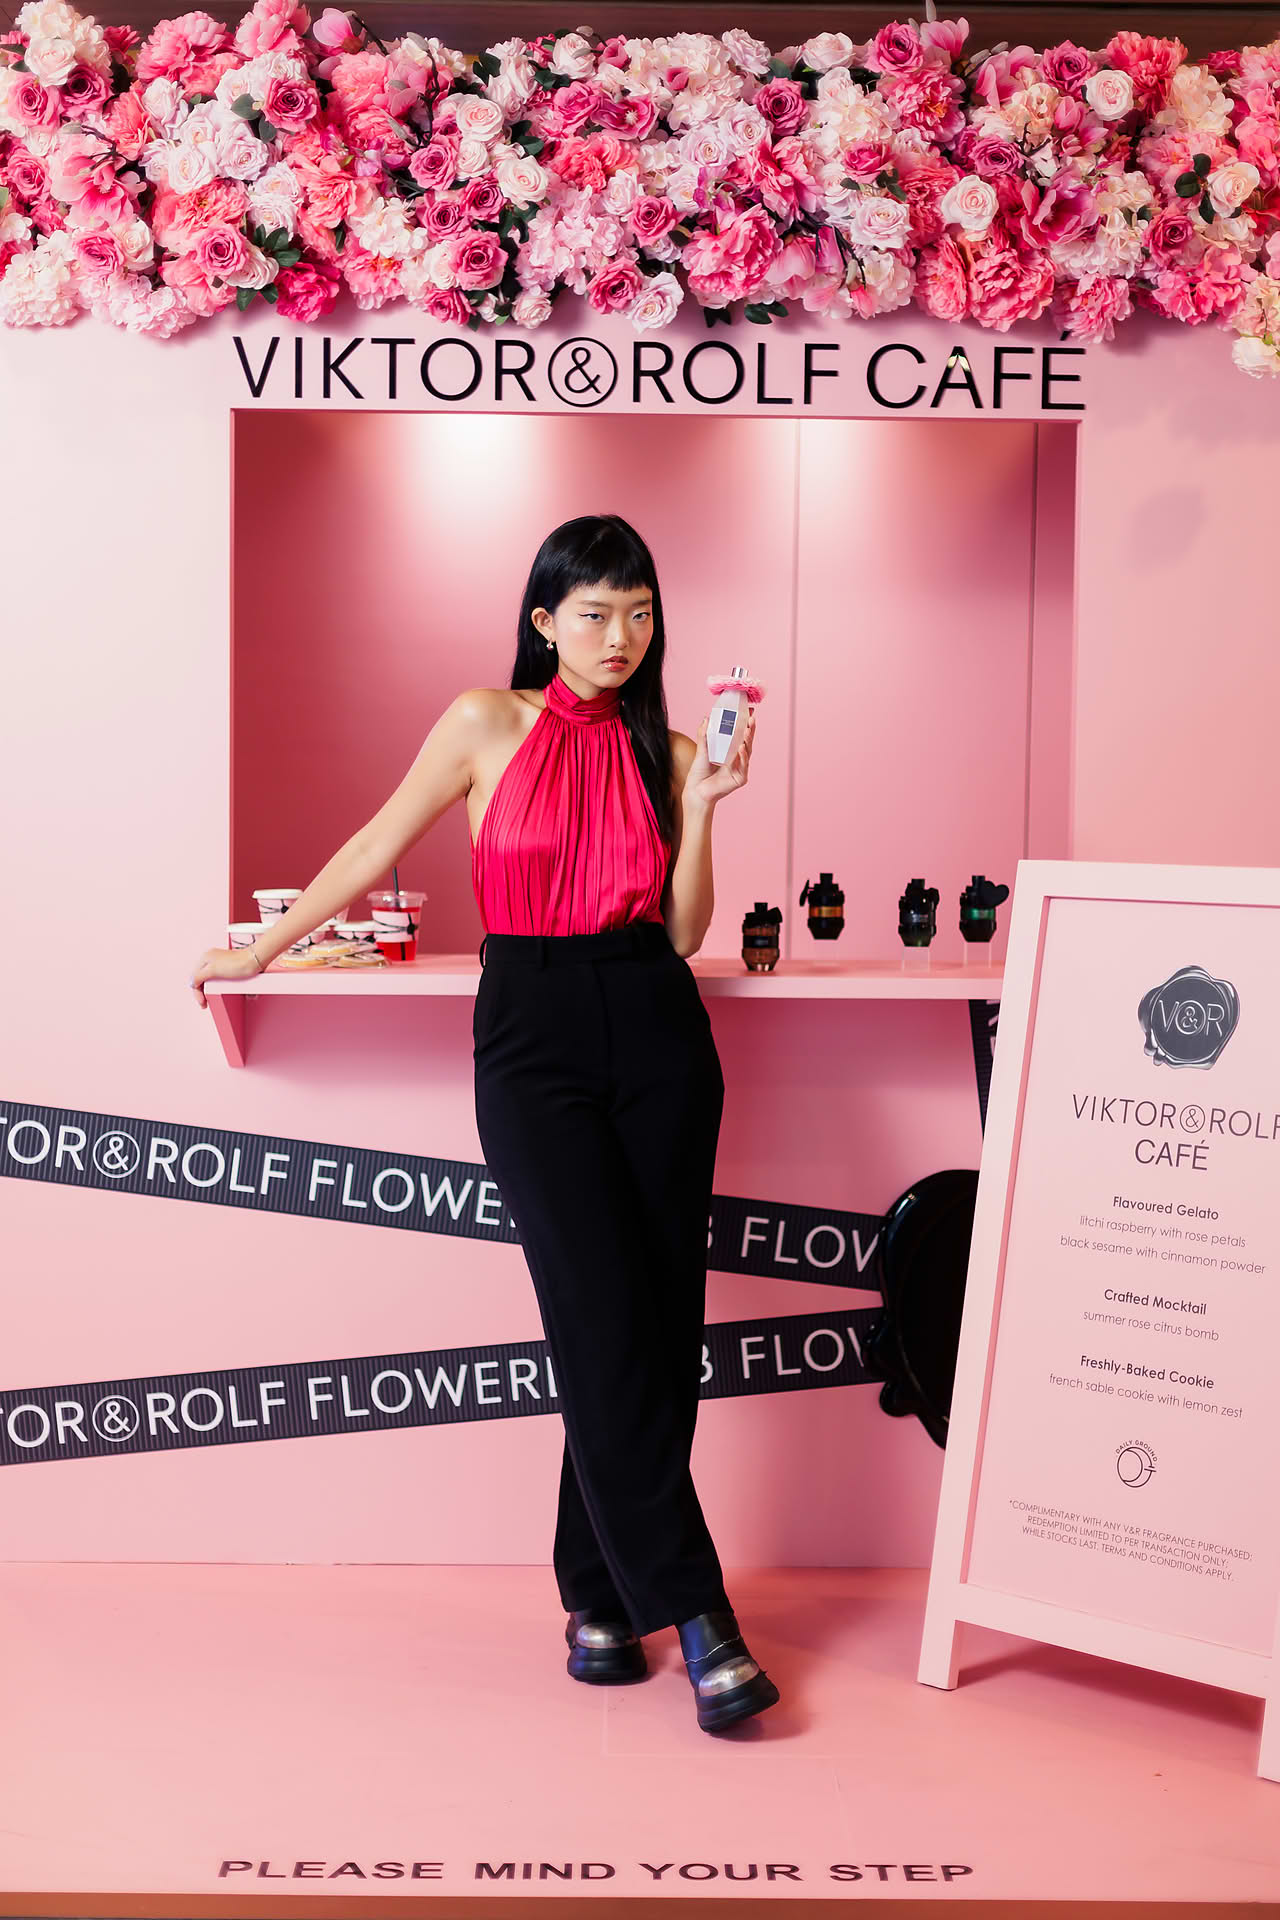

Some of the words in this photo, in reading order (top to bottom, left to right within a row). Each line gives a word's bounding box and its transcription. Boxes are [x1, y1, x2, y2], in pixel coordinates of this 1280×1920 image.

[233, 336, 840, 407] VIKTOR&ROLF
[1159, 1000, 1224, 1037] V&R
[1135, 1139, 1210, 1171] CAFÉ
[0, 1117, 290, 1195] OR&ROLF
[308, 1158, 518, 1229] FLOWE
[1113, 1196, 1173, 1214] Flavoured
[1176, 1204, 1219, 1220] Gelato
[1079, 1215, 1104, 1228] litchi
[1106, 1219, 1157, 1238] raspberry
[1160, 1226, 1182, 1239] with
[1185, 1231, 1208, 1243] rose
[1211, 1233, 1246, 1248] petals
[1060, 1235, 1089, 1249] black
[1092, 1241, 1133, 1255] sesame
[1136, 1246, 1158, 1259] with
[1161, 1249, 1217, 1267] cinnamon
[1220, 1258, 1266, 1274] powder
[1104, 1289, 1149, 1306] Crafted
[1152, 1296, 1207, 1315] Mocktail
[1083, 1311, 1126, 1326] summer
[1128, 1319, 1150, 1330] rose
[1154, 1321, 1182, 1335] citrus
[1185, 1326, 1220, 1341] bomb
[1080, 1355, 1166, 1380] Freshly-Baked
[1169, 1370, 1215, 1389] Cookie
[1049, 1373, 1083, 1389] french
[1085, 1380, 1114, 1395] sable
[1117, 1387, 1154, 1402] cookie
[1157, 1394, 1180, 1407] with
[1183, 1397, 1218, 1414] lemon
[1221, 1406, 1243, 1419] zest
[0, 1381, 286, 1449] OR&ROLF
[1115, 1440, 1132, 1454] DAILY
[1135, 1439, 1158, 1462] GROUND
[1027, 1515, 1078, 1534] REDEMPTION
[1079, 1527, 1109, 1541] LIMITED
[1111, 1534, 1122, 1544] TO
[1124, 1536, 1139, 1547] PER
[1141, 1540, 1201, 1561] TRANSACTION
[1082, 1516, 1101, 1527] WITH
[1103, 1520, 1121, 1531] ANY
[1123, 1525, 1141, 1536] V&R
[1142, 1529, 1196, 1549] FRAGRANCE
[1022, 1526, 1045, 1539] WHILE
[1046, 1531, 1077, 1546] STOCKS
[1101, 1543, 1127, 1557] TERMS
[1128, 1550, 1148, 1561] AND
[1149, 1554, 1203, 1574] CONDITIONS
[218, 1860, 444, 1880] PLEASE
[474, 1861, 616, 1881] MIND
[637, 1862, 804, 1882] YOUR
[829, 1863, 974, 1883] STEP
